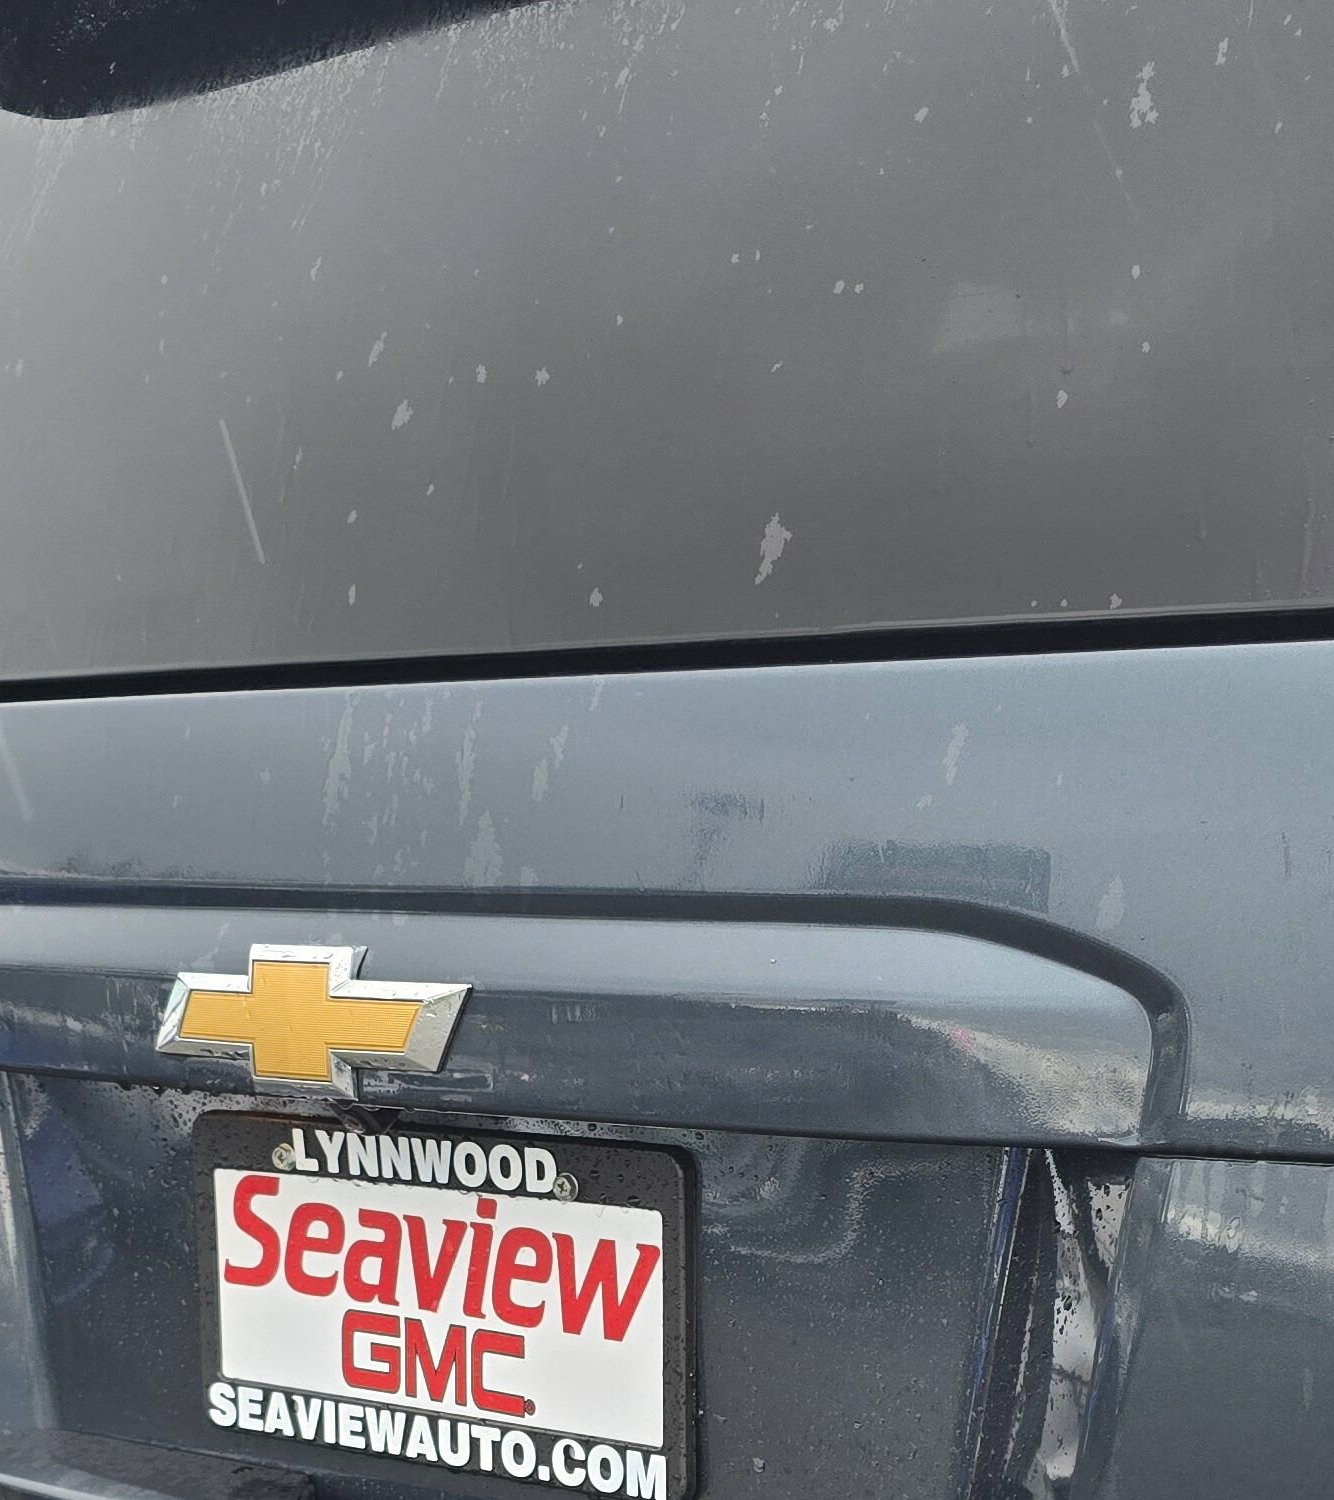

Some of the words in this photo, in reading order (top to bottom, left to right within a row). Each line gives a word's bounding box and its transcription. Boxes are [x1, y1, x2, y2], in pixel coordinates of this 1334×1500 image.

[292, 1128, 558, 1195] LYNNWOOD
[223, 1174, 661, 1342] Seaview
[341, 1309, 526, 1417] GMC
